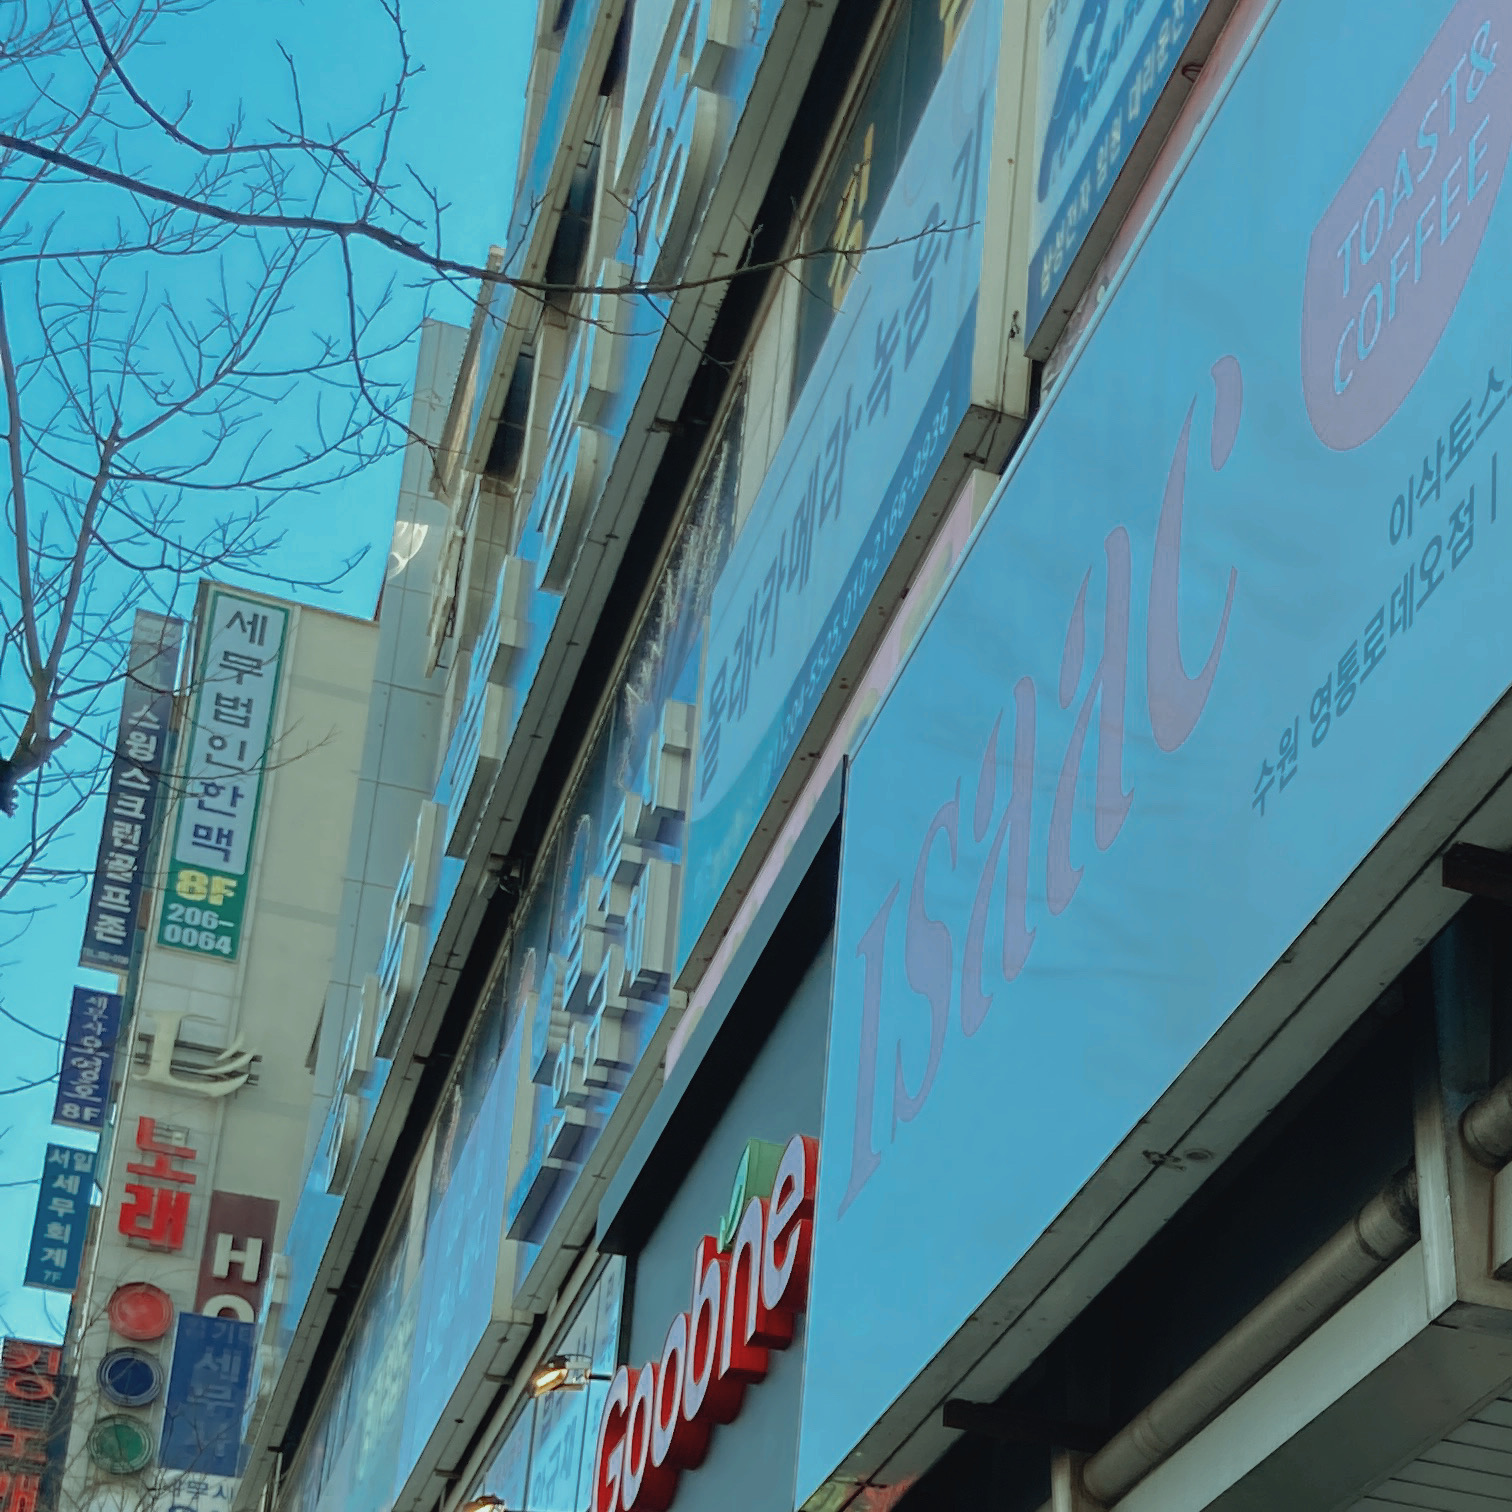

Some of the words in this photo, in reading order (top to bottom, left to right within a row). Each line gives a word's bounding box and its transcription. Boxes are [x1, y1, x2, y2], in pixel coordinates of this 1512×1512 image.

[1335, 113, 1492, 397] COFFEE
[1252, 715, 1300, 818] 수원
[1309, 490, 1476, 750] 영통로데오점
[176, 868, 238, 907] 8F
